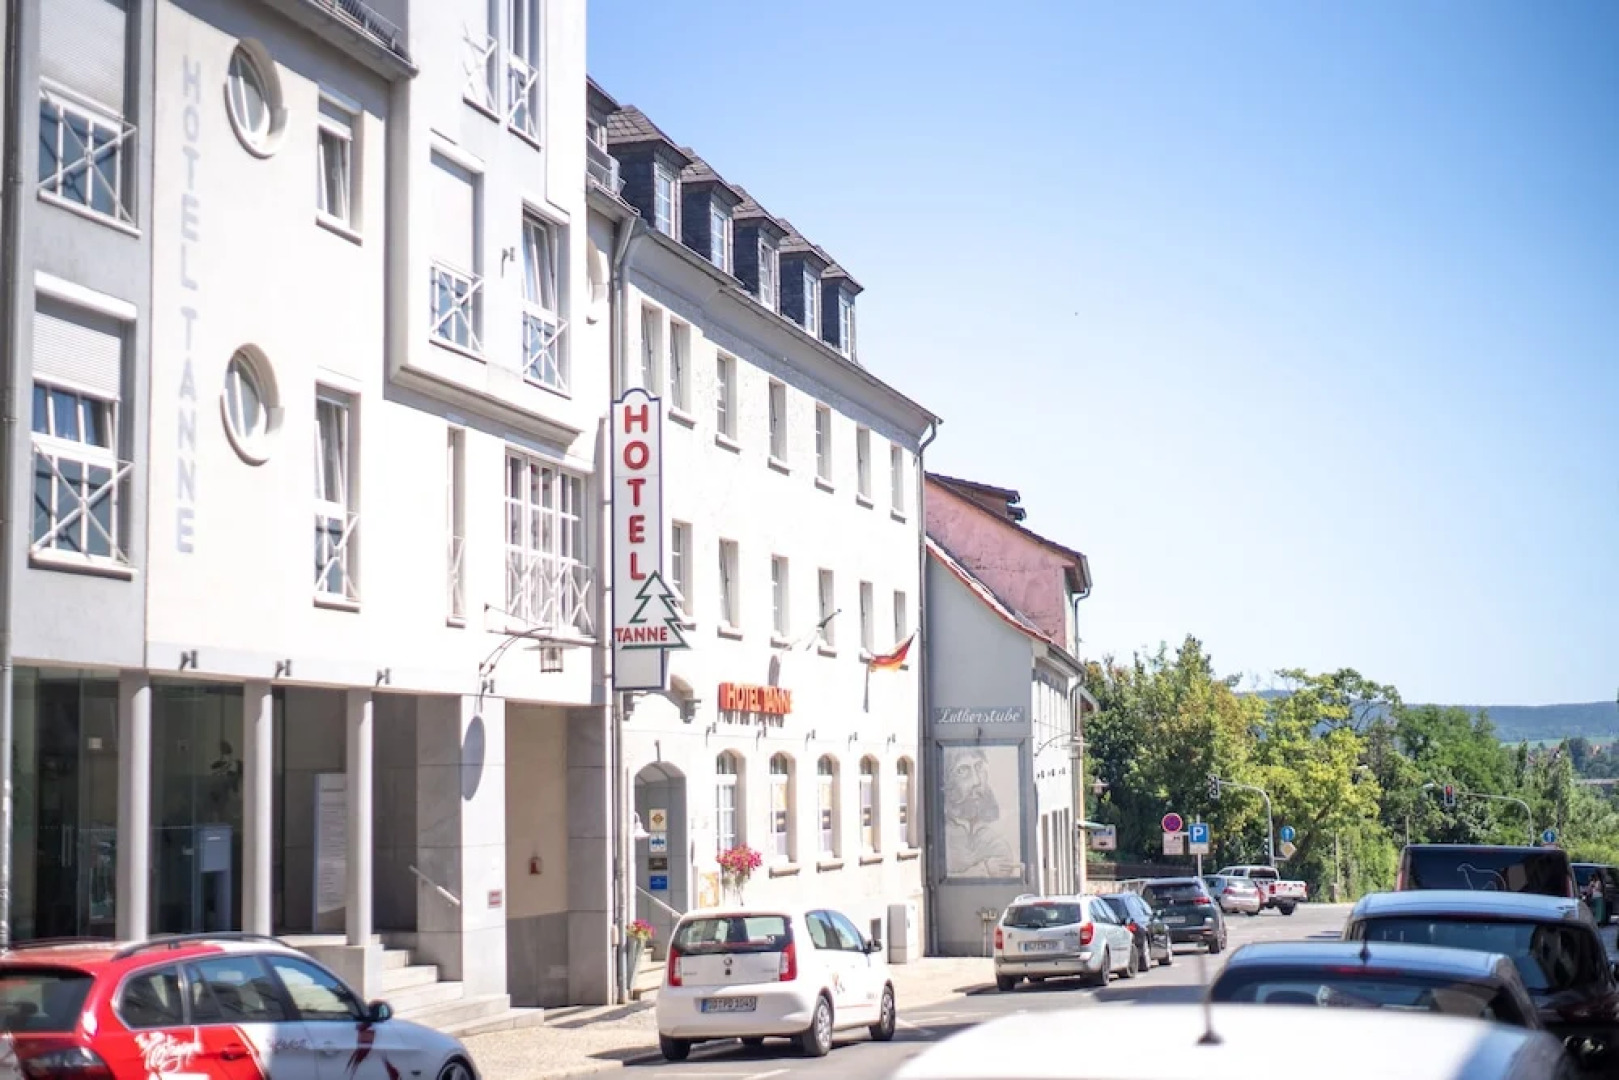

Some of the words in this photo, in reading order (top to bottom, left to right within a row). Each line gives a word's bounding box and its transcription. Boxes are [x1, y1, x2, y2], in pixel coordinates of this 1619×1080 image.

[181, 54, 200, 291] HOTEL
[176, 306, 198, 554] TANNE
[623, 404, 649, 581] HOTEL
[615, 627, 667, 643] TANNE
[721, 683, 762, 712] HOTEL
[1193, 827, 1203, 841] P
